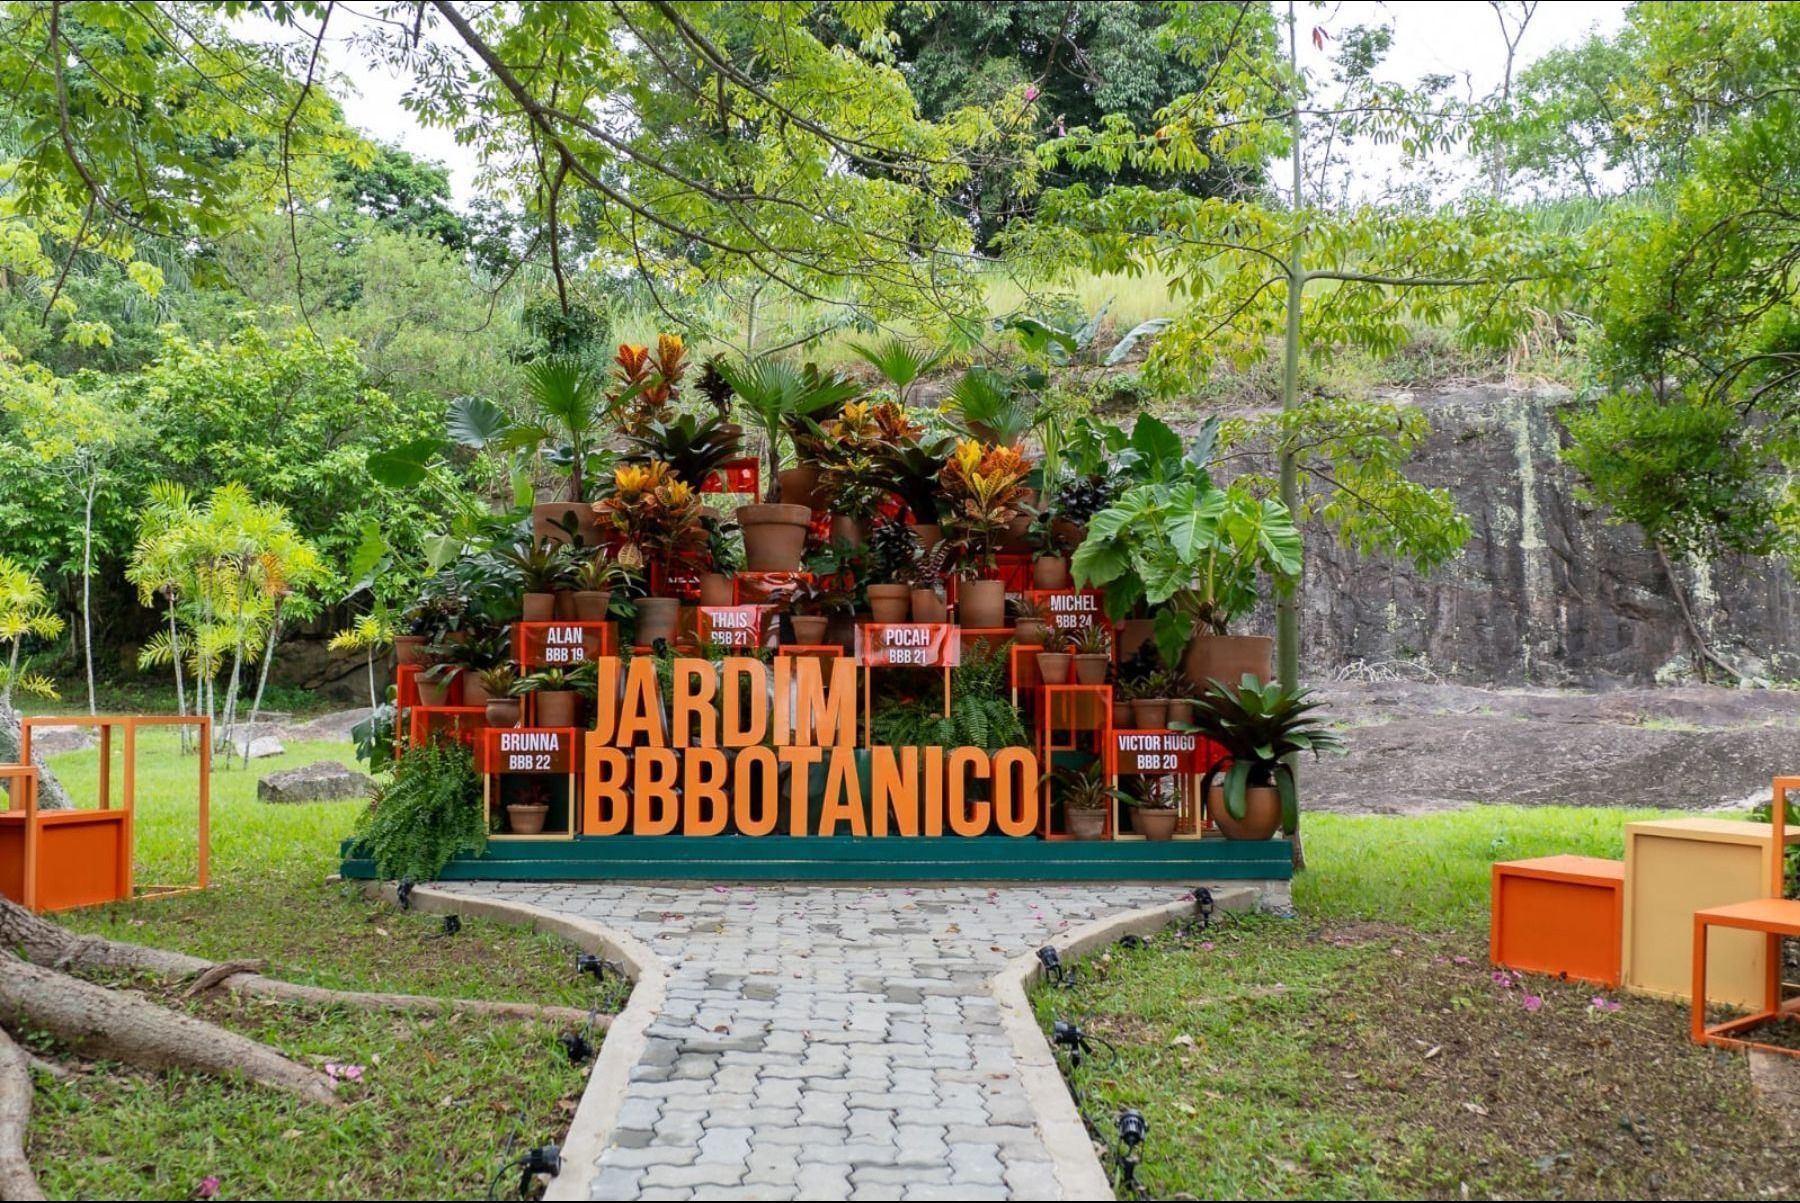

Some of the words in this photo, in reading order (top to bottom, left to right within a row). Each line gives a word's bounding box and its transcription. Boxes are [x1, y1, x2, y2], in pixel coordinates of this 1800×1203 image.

[1050, 594, 1097, 611] MICHEL
[711, 612, 747, 628] THAIS
[1079, 615, 1093, 628] 24
[547, 627, 583, 644] ALAN
[734, 631, 747, 645] 21
[886, 629, 930, 646] POCAH
[545, 648, 568, 662] BBB
[571, 648, 584, 661] 19
[889, 649, 911, 663] BBB
[914, 649, 926, 663] 21
[586, 656, 857, 748] JARDIM
[501, 733, 559, 751] BRUNNA
[1119, 735, 1161, 751] VICTOR
[1164, 735, 1195, 751] HUGO
[509, 755, 533, 770] BBB
[535, 755, 551, 770] 22
[1137, 754, 1160, 769] BBB
[1163, 755, 1177, 769] 20
